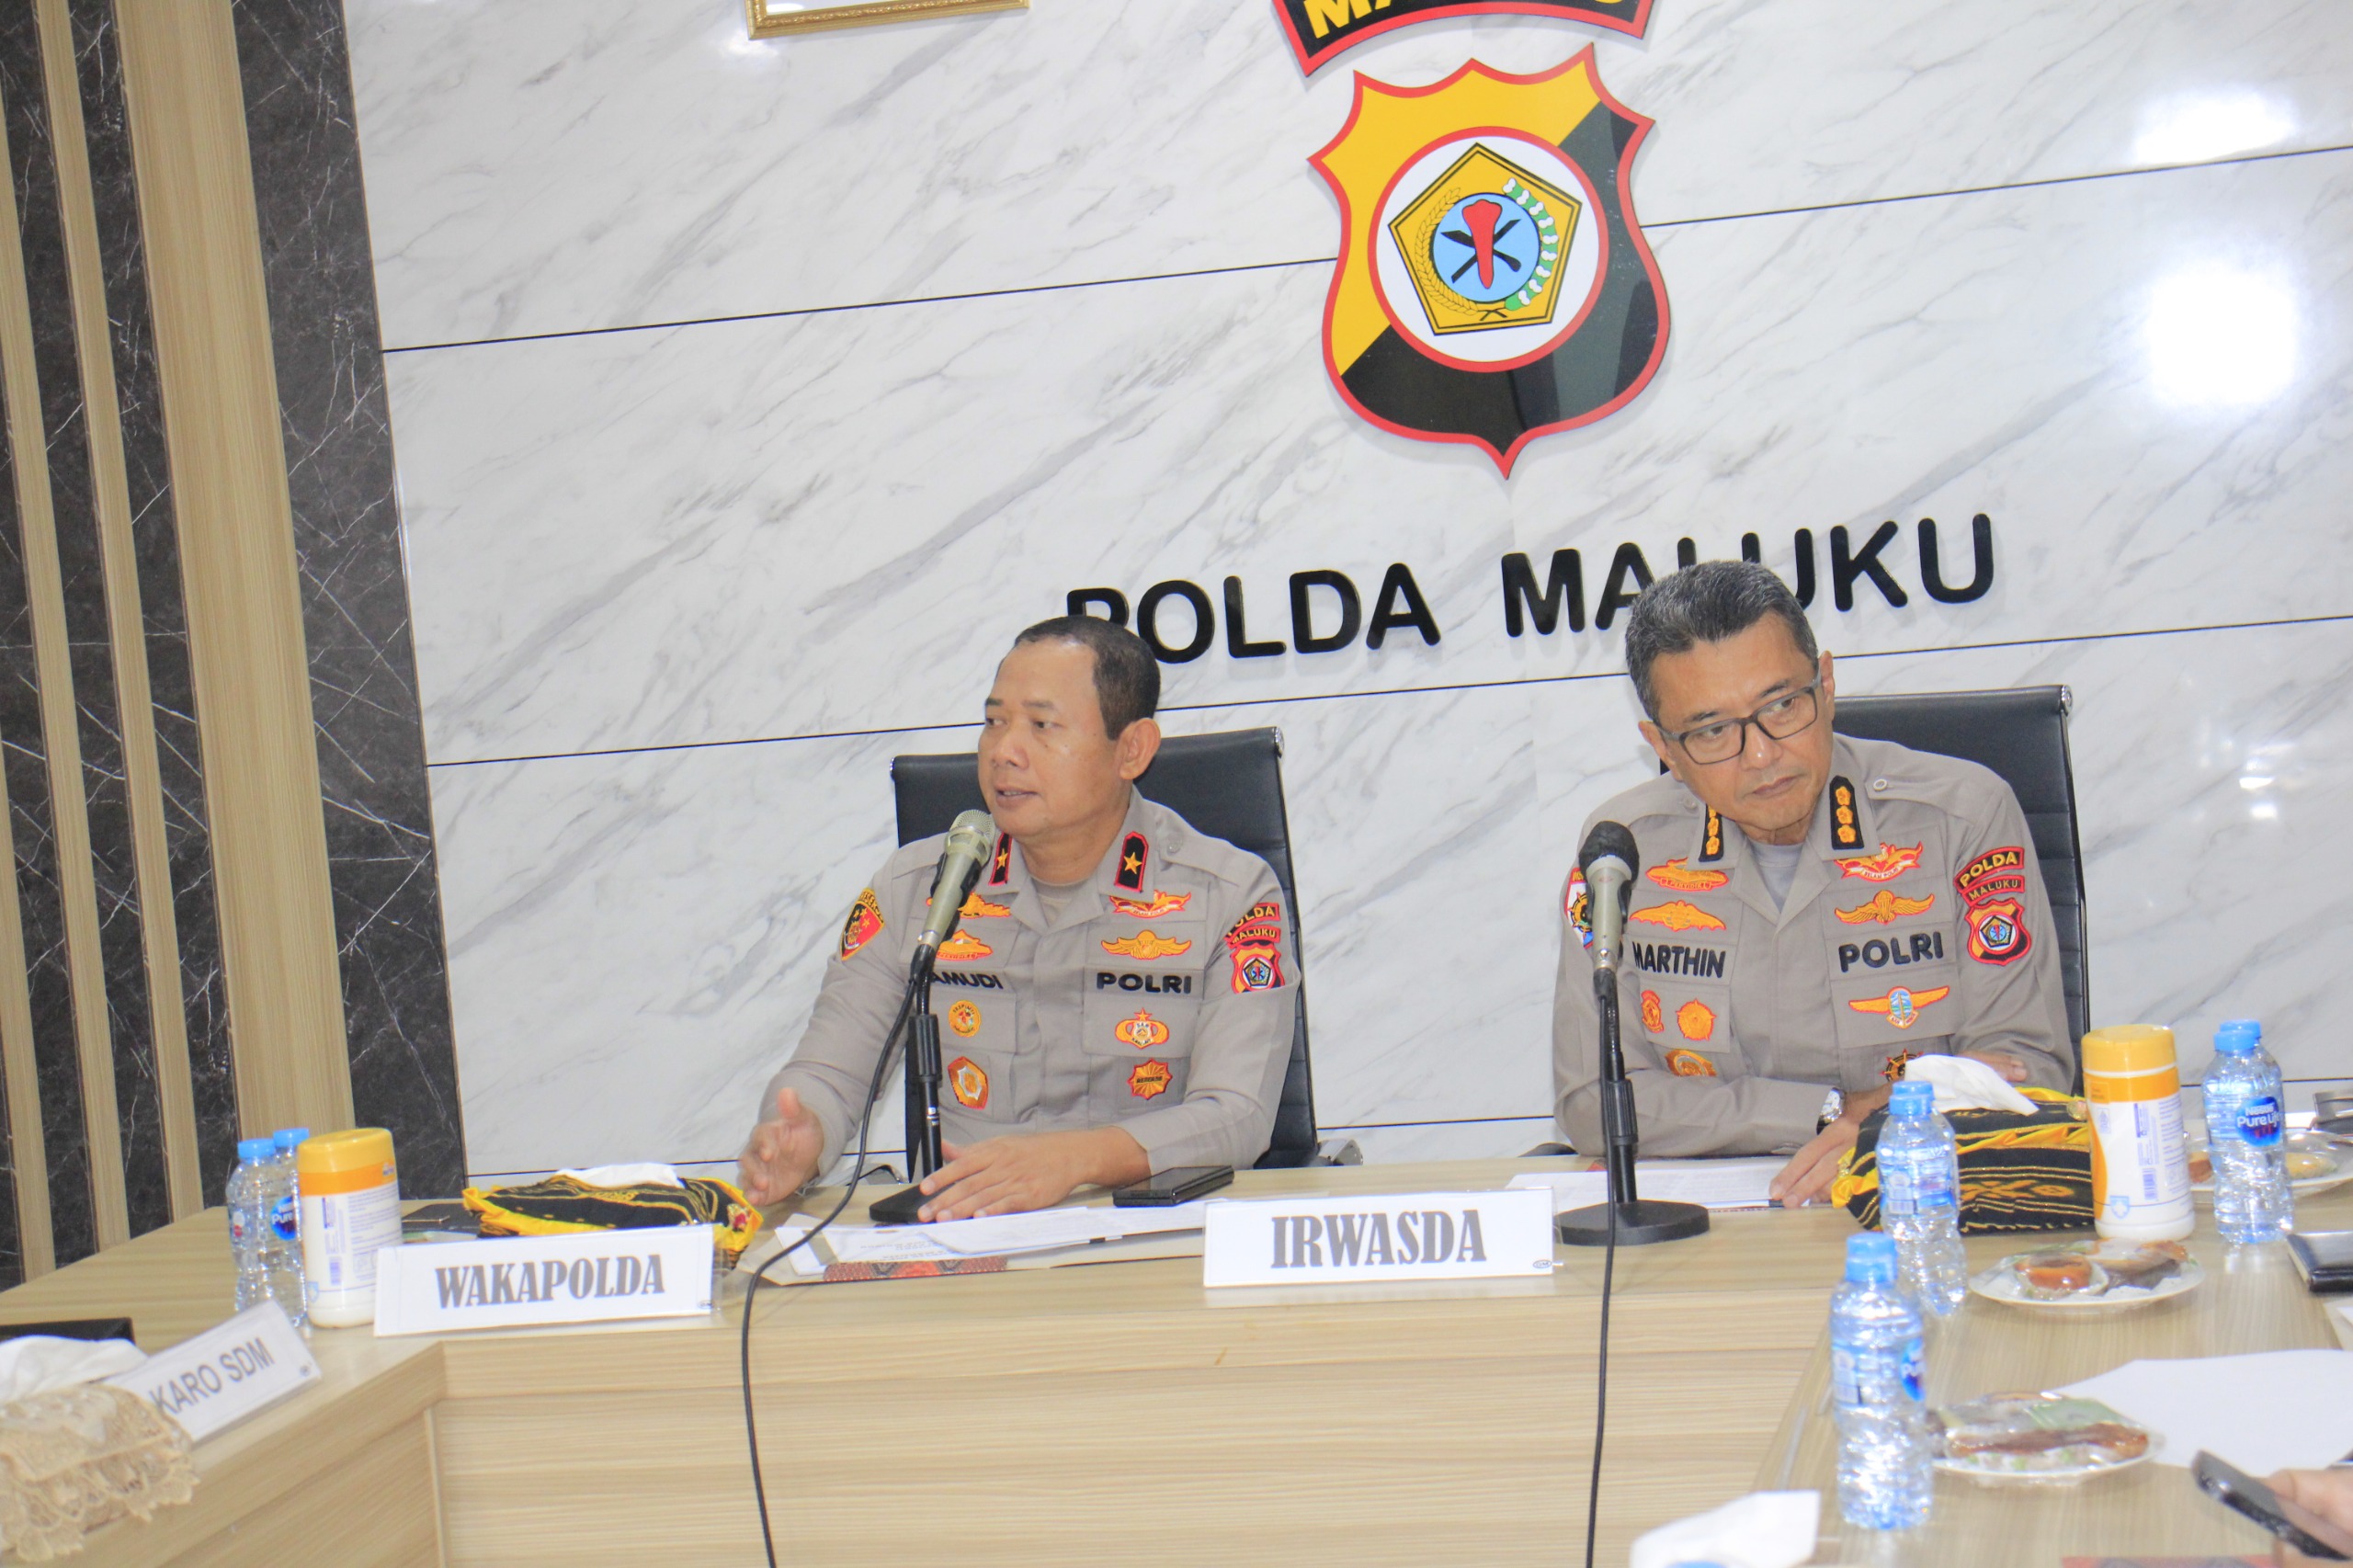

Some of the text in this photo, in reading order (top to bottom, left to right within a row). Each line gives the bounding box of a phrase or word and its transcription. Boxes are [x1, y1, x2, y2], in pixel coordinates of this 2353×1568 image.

[1500, 513, 1994, 639] MAUKU
[1960, 851, 2018, 887] POLDA
[1969, 880, 2018, 901] MALUKU
[1232, 928, 1276, 944] MALUKU
[1838, 931, 1944, 972] POLRI
[1632, 941, 1726, 978] MARTHIN
[930, 971, 1004, 990] AMUDI
[1097, 971, 1192, 994] POLRI
[2237, 1115, 2268, 1129] Pure
[1270, 1209, 1487, 1269] IRWASDA
[435, 1254, 665, 1309] WAKAPOLDA
[149, 1337, 275, 1414] KARO SDM
